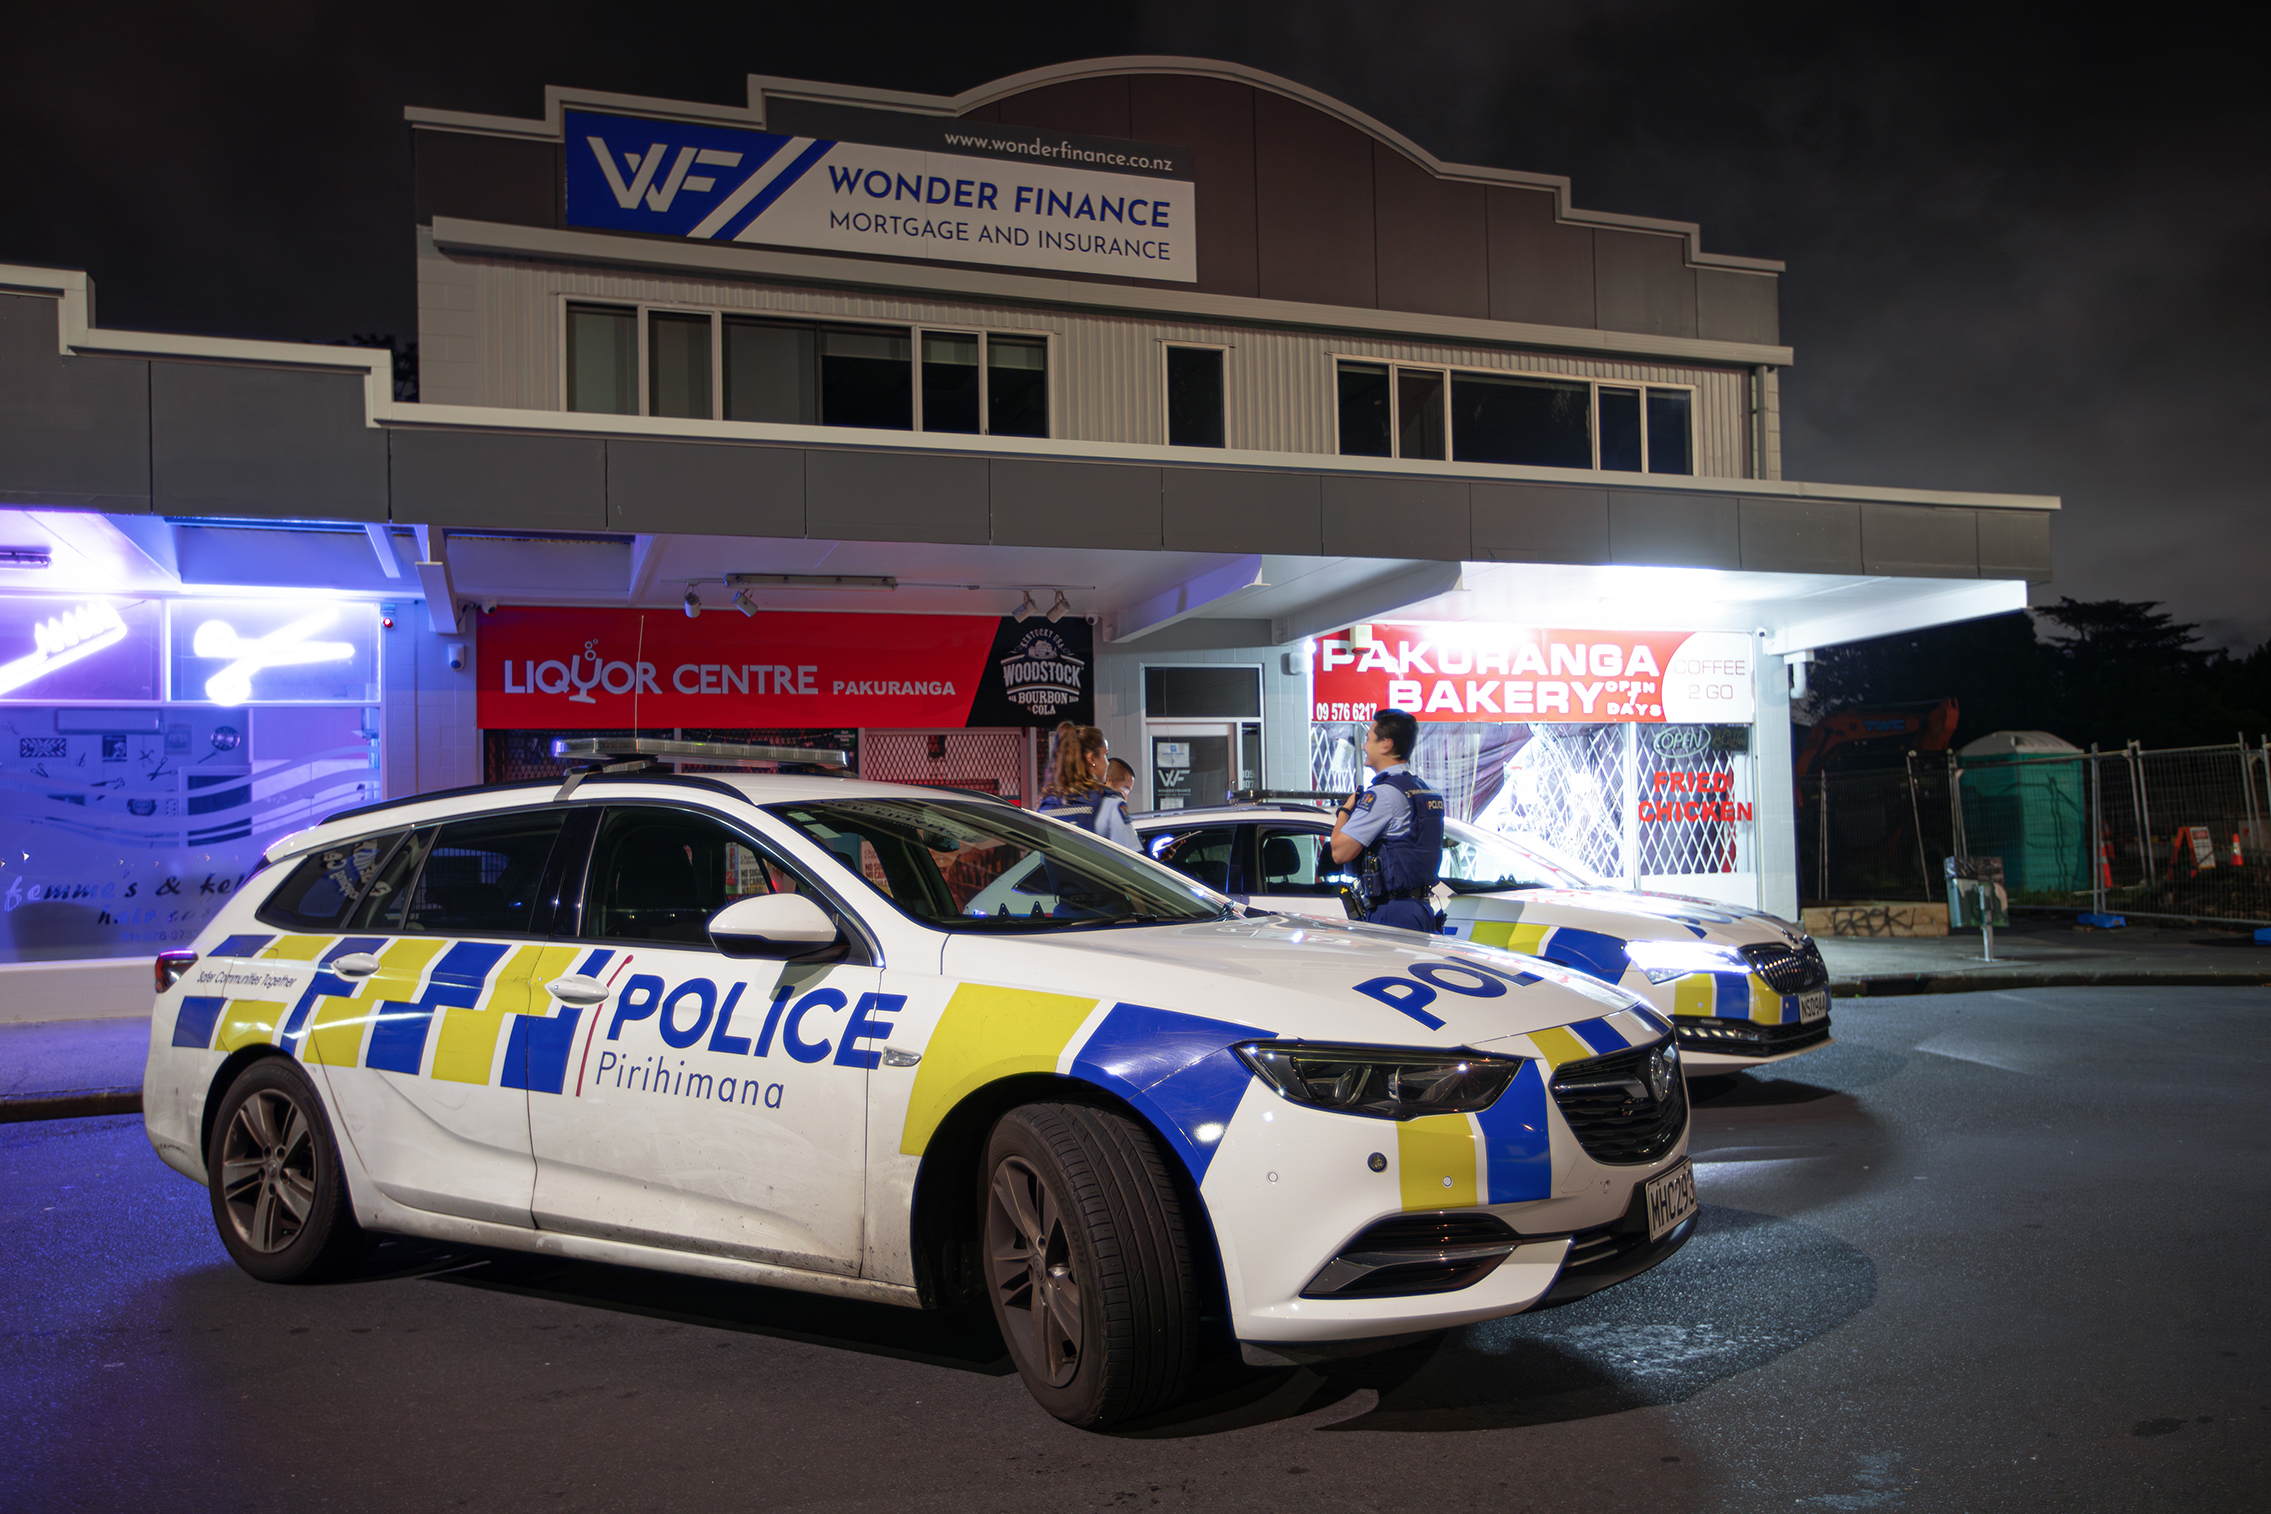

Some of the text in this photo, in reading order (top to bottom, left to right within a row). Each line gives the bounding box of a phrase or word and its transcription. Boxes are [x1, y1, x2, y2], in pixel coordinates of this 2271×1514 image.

[944, 131, 1173, 171] www.wonderfinance.co.nz
[586, 135, 744, 212] WF
[828, 164, 1171, 228] WONDER FINANCE
[830, 210, 1171, 261] MORTGAGE AND INSURANCE
[1020, 628, 1065, 649] KENTUCKY USA
[1322, 639, 1660, 677] PAKURANGA
[1674, 659, 1746, 675] COFFEE
[504, 653, 956, 704] LIQUOR CENTRE PAKURANGA
[1003, 660, 1081, 689] WOODSTOCK
[1018, 690, 1068, 704] BOURBON
[1389, 679, 1604, 713] BAKERY
[1604, 680, 1656, 694] OPEN
[1627, 690, 1639, 706] 7
[1688, 684, 1734, 700] 2 GO
[1032, 703, 1056, 715] COLA
[1316, 702, 1377, 720] 09 576 6217
[1606, 702, 1662, 717] DAYS
[1661, 730, 1702, 749] OPEN
[1654, 771, 1728, 793] FRIED
[1638, 800, 1752, 822] CHICKEN
[155, 875, 181, 896] &
[197, 970, 297, 989] Safer Communities Together
[606, 973, 908, 1070] POLICE
[595, 1050, 785, 1110] Pirihimana
[1650, 1168, 1695, 1232] MHC293
